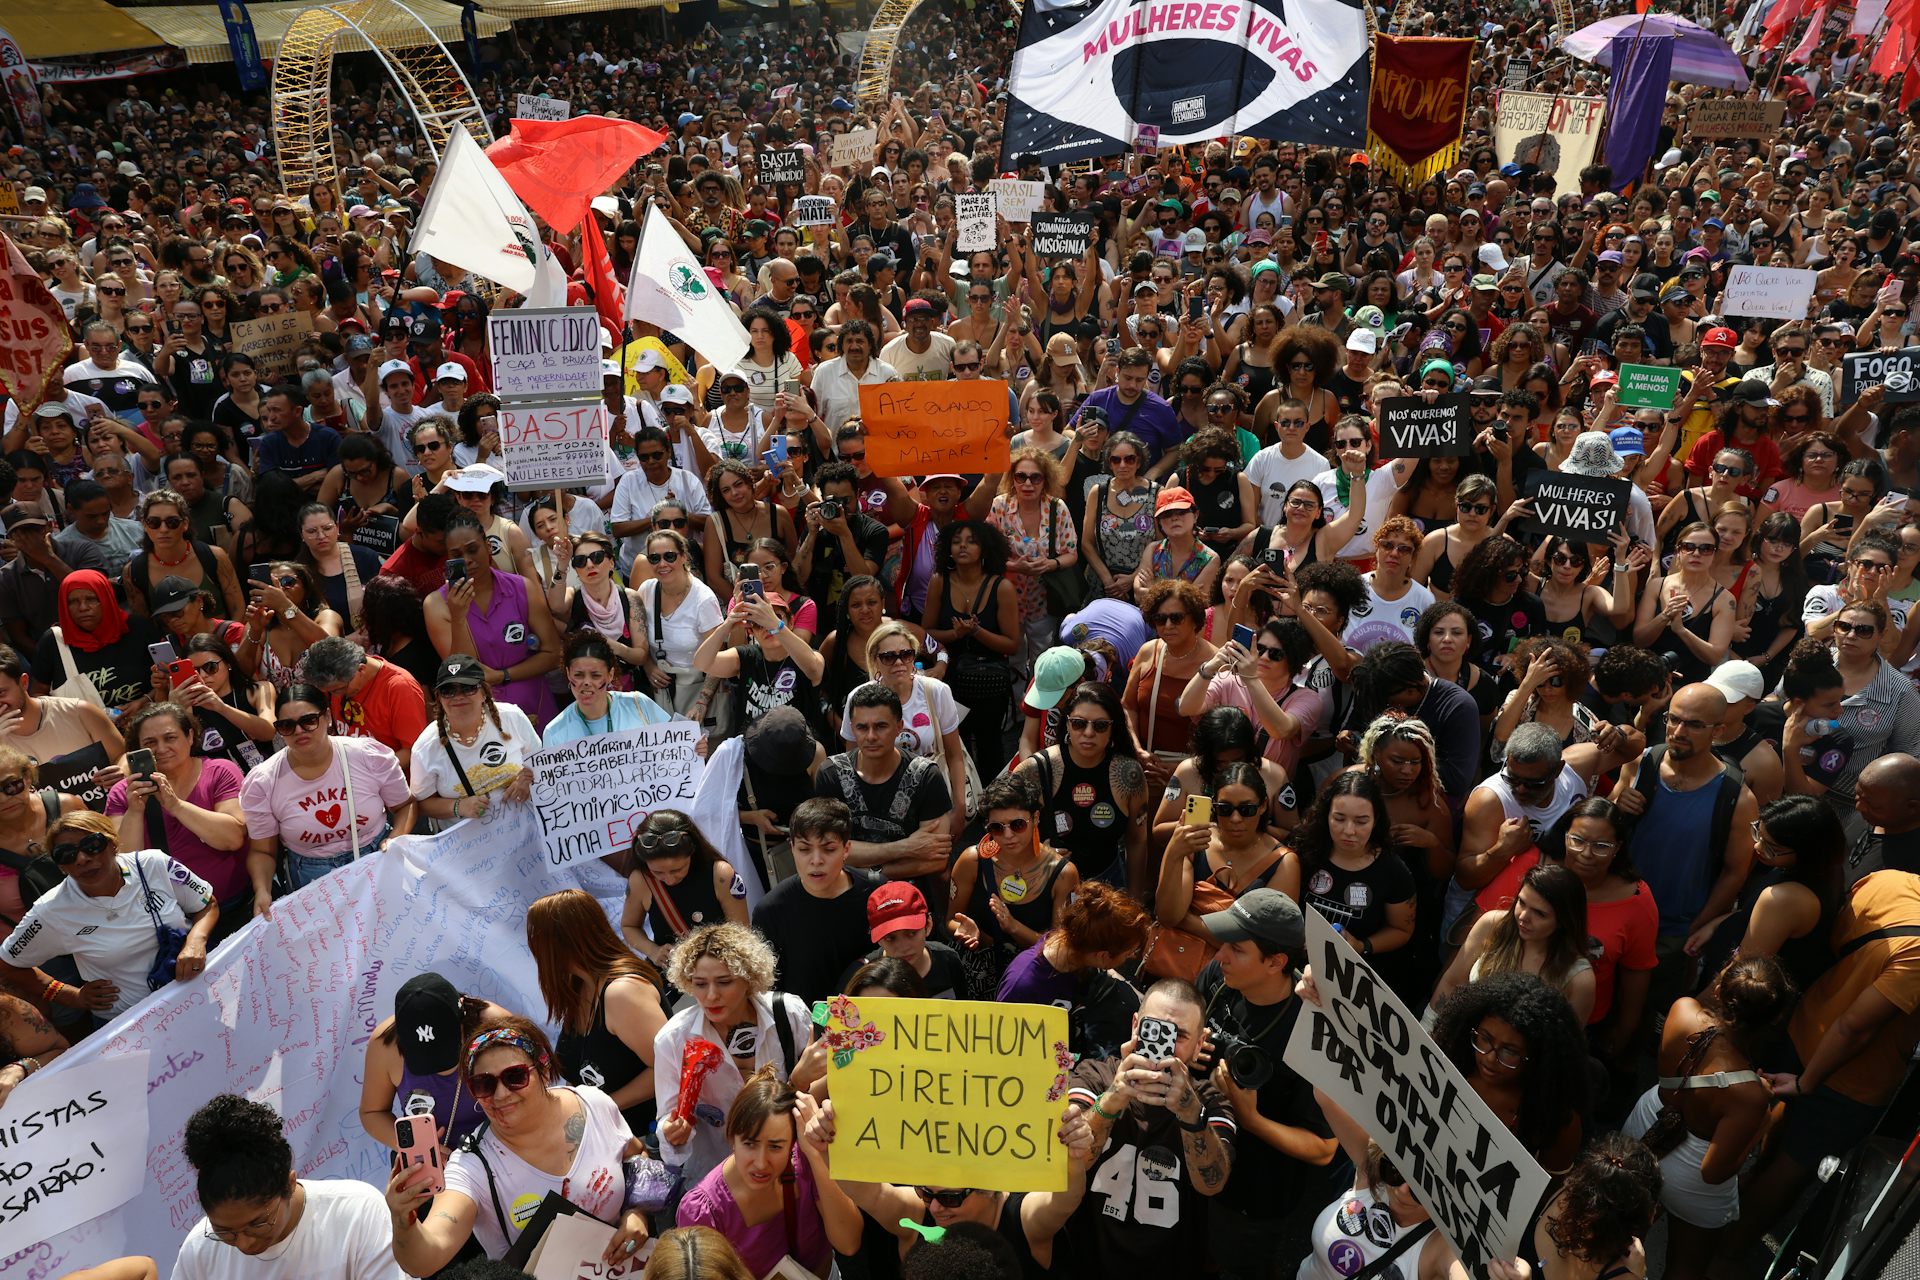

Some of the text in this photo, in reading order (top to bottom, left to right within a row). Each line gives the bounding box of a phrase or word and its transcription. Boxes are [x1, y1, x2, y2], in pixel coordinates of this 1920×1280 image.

[1083, 3, 1318, 82] MULHERES VIVAS
[519, 95, 550, 108] CHEGA DE
[1372, 68, 1464, 124] AFRONTE
[1174, 98, 1203, 113] BANCADA
[1700, 101, 1767, 112] ACORDADA NO
[1174, 108, 1205, 122] FEMINISTA
[1697, 112, 1729, 122] LUGAR
[1732, 111, 1746, 121] EM
[760, 152, 799, 170] BASTA
[760, 169, 804, 183] FEMINICÍDIO!
[992, 182, 1038, 198] BRASIL
[960, 197, 990, 206] PARE DE
[961, 204, 990, 214] MATAR
[1002, 198, 1026, 207] SEM
[800, 206, 832, 221] MATA
[960, 211, 993, 222] MULHERES
[1036, 222, 1090, 236] CRIMINALIZAÇÃO
[1034, 236, 1086, 254] MISOGINIA
[258, 321, 276, 334] VAI
[282, 318, 296, 330] SE
[241, 334, 294, 352] ARREPENDER
[491, 315, 598, 356] FEMINICÍDIO
[507, 360, 536, 370] CAÇA
[562, 354, 600, 366] BRUXAS
[1854, 356, 1912, 380] FOGO
[508, 376, 521, 385] DA
[1629, 372, 1670, 384] NEM UMA
[1626, 382, 1668, 392] A MENOS!
[879, 392, 992, 416] ATÉ QUANDO
[1388, 406, 1458, 421] NOS QUEREMOS
[502, 408, 608, 444] BASTA!
[932, 427, 968, 438] NOS
[1390, 420, 1456, 449] VIVAS!
[537, 443, 550, 451] POR
[554, 441, 600, 450] TODAS!
[900, 444, 975, 464] MATAR
[506, 468, 574, 482] MULHERES
[1538, 484, 1615, 506] MULHERES
[1534, 502, 1616, 531] VIVAS!
[376, 530, 392, 540] NOS
[1352, 624, 1392, 640] MULHERES
[676, 775, 696, 799] É
[298, 787, 348, 812] MAKE
[326, 814, 335, 824] it
[8, 919, 43, 959] NETSHOES
[1324, 940, 1410, 1056] NÃO
[416, 1024, 436, 1043] NY
[894, 1014, 1047, 1060] NENHUM
[1310, 1010, 1364, 1095] POR
[855, 1117, 1054, 1163] A MENOS!
[1090, 1143, 1180, 1229] 46
[1104, 1204, 1121, 1218] EST.
